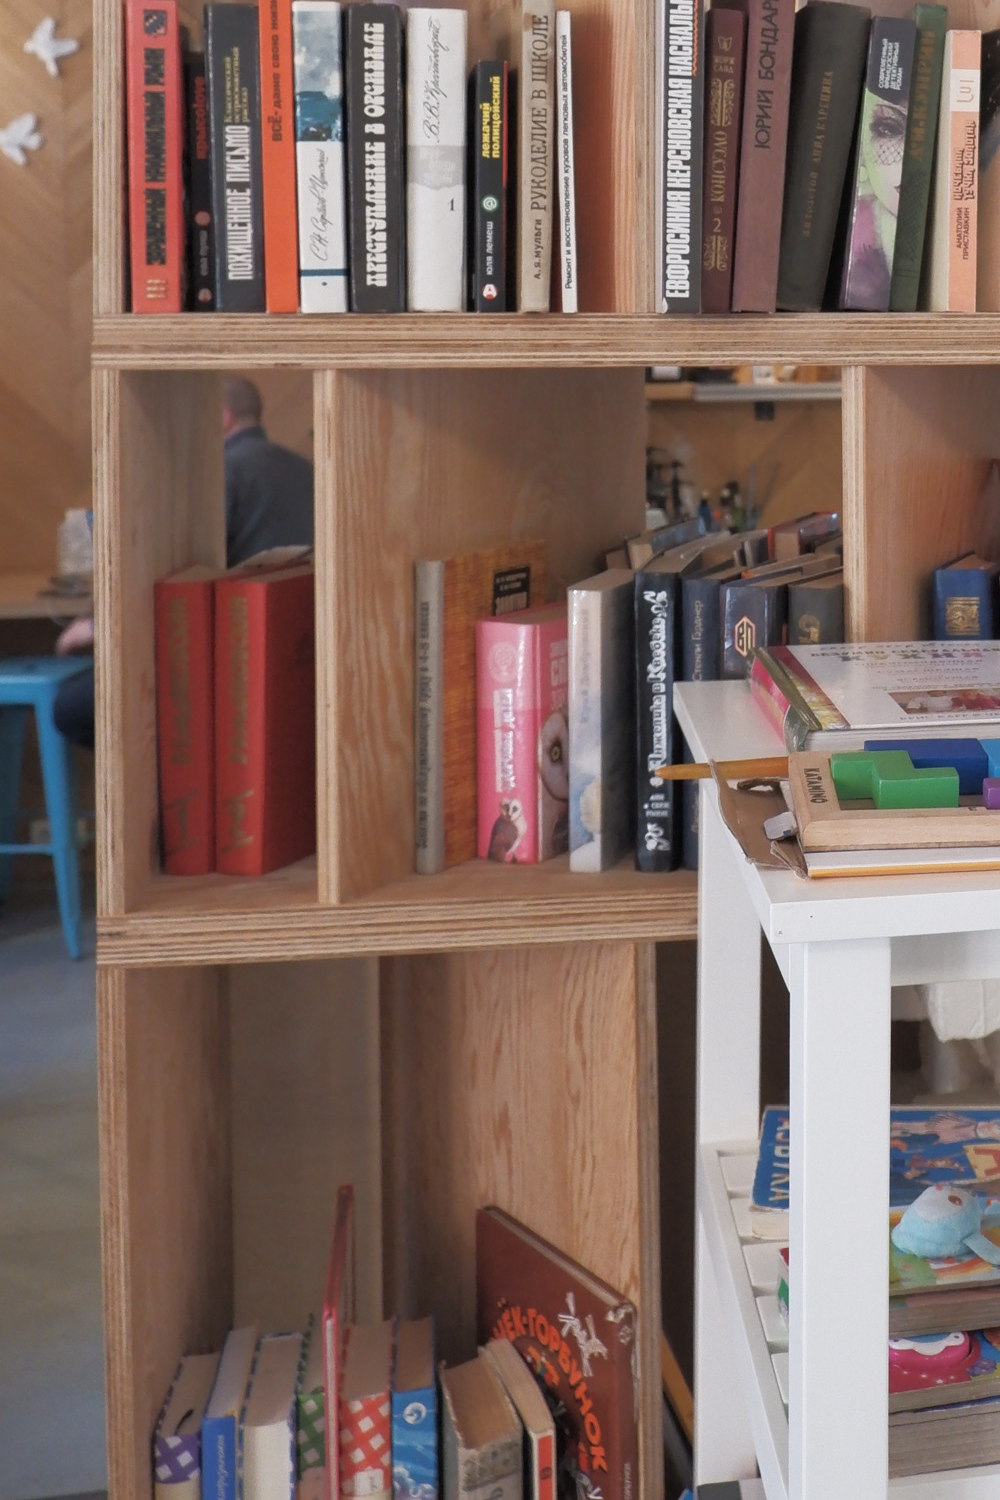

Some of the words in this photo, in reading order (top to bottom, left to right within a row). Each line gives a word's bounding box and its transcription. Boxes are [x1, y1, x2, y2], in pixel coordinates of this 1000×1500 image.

[270, 33, 279, 68] свою
[363, 22, 385, 116] ОРСИВАЛЕ
[531, 13, 548, 82] ШКОЛЕ
[559, 34, 567, 92] автомобилей
[876, 38, 890, 88] СОВРЕМЕННЫЙ
[881, 42, 896, 89] ФРАНЦУЗСКИЙ
[887, 41, 902, 90] ДЕТЕКТИВНЫЙ
[222, 56, 233, 123] Классический
[241, 86, 251, 122] рассказ
[271, 72, 282, 109] даже
[531, 89, 546, 99] В
[816, 70, 834, 131] КАРЕНИНА
[894, 67, 904, 91] РОМАН
[365, 122, 385, 134] В
[480, 102, 490, 158] лежачий
[489, 75, 501, 158] полицейский
[561, 93, 569, 136] легковых
[666, 78, 692, 188] КЕРСНОВСКАЯ
[753, 89, 774, 148] ЮРИЙ
[222, 123, 251, 182] ПИСЬМО
[530, 107, 547, 211] РУКОДЕЛИЕ
[562, 138, 570, 173] кузовов
[710, 130, 727, 202] КОНСУЭЛО
[964, 120, 976, 165] ЗОЛОТАЯ
[952, 147, 964, 200] НОЧЕВАЛА
[964, 168, 975, 199] ТУЧКА
[364, 141, 387, 287] ПРЕСТУПЛЕНИЕ
[449, 197, 454, 211] 1
[563, 176, 571, 247] восстановление
[713, 217, 721, 232] 2
[223, 187, 255, 280] ПОХИЩЕННОЕ
[485, 221, 493, 254] лемеш
[664, 190, 691, 298] ЕВФРОСИНИЯ
[962, 207, 970, 260] ПРИСТАВКИН
[564, 257, 572, 289] Ремонт
[691, 599, 703, 640] Гарднер
[646, 617, 664, 681] Квебеке
[802, 767, 827, 804] KATAMINO
